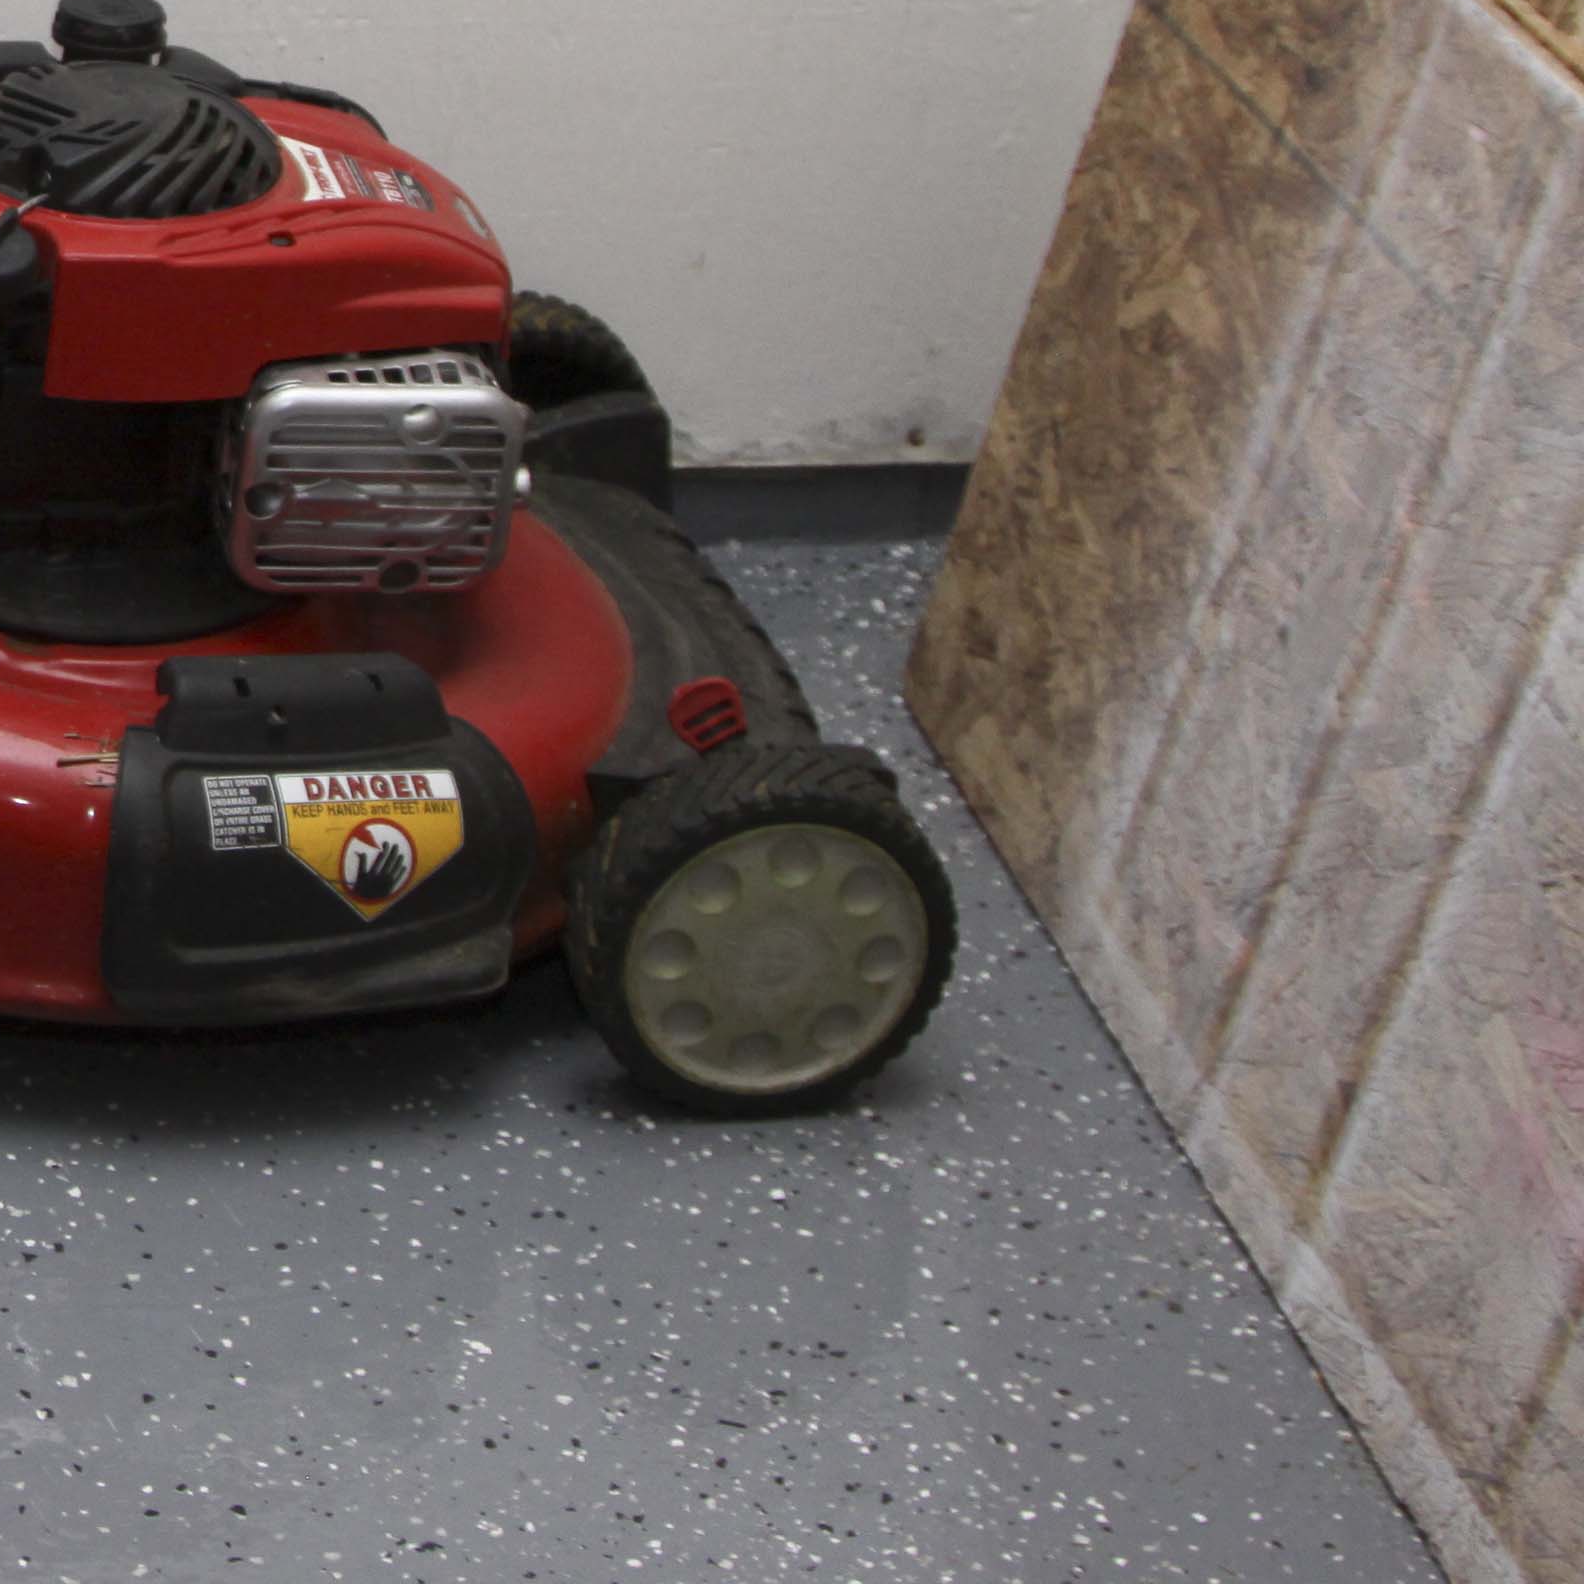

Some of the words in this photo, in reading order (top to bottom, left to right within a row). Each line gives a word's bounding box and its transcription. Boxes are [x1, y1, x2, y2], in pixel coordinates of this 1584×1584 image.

[303, 775, 433, 801] DANGER
[292, 804, 324, 818] KEEP
[327, 802, 367, 816] HANDS
[370, 803, 392, 816] and
[393, 801, 420, 815] FEET
[423, 801, 455, 814] AWAY
